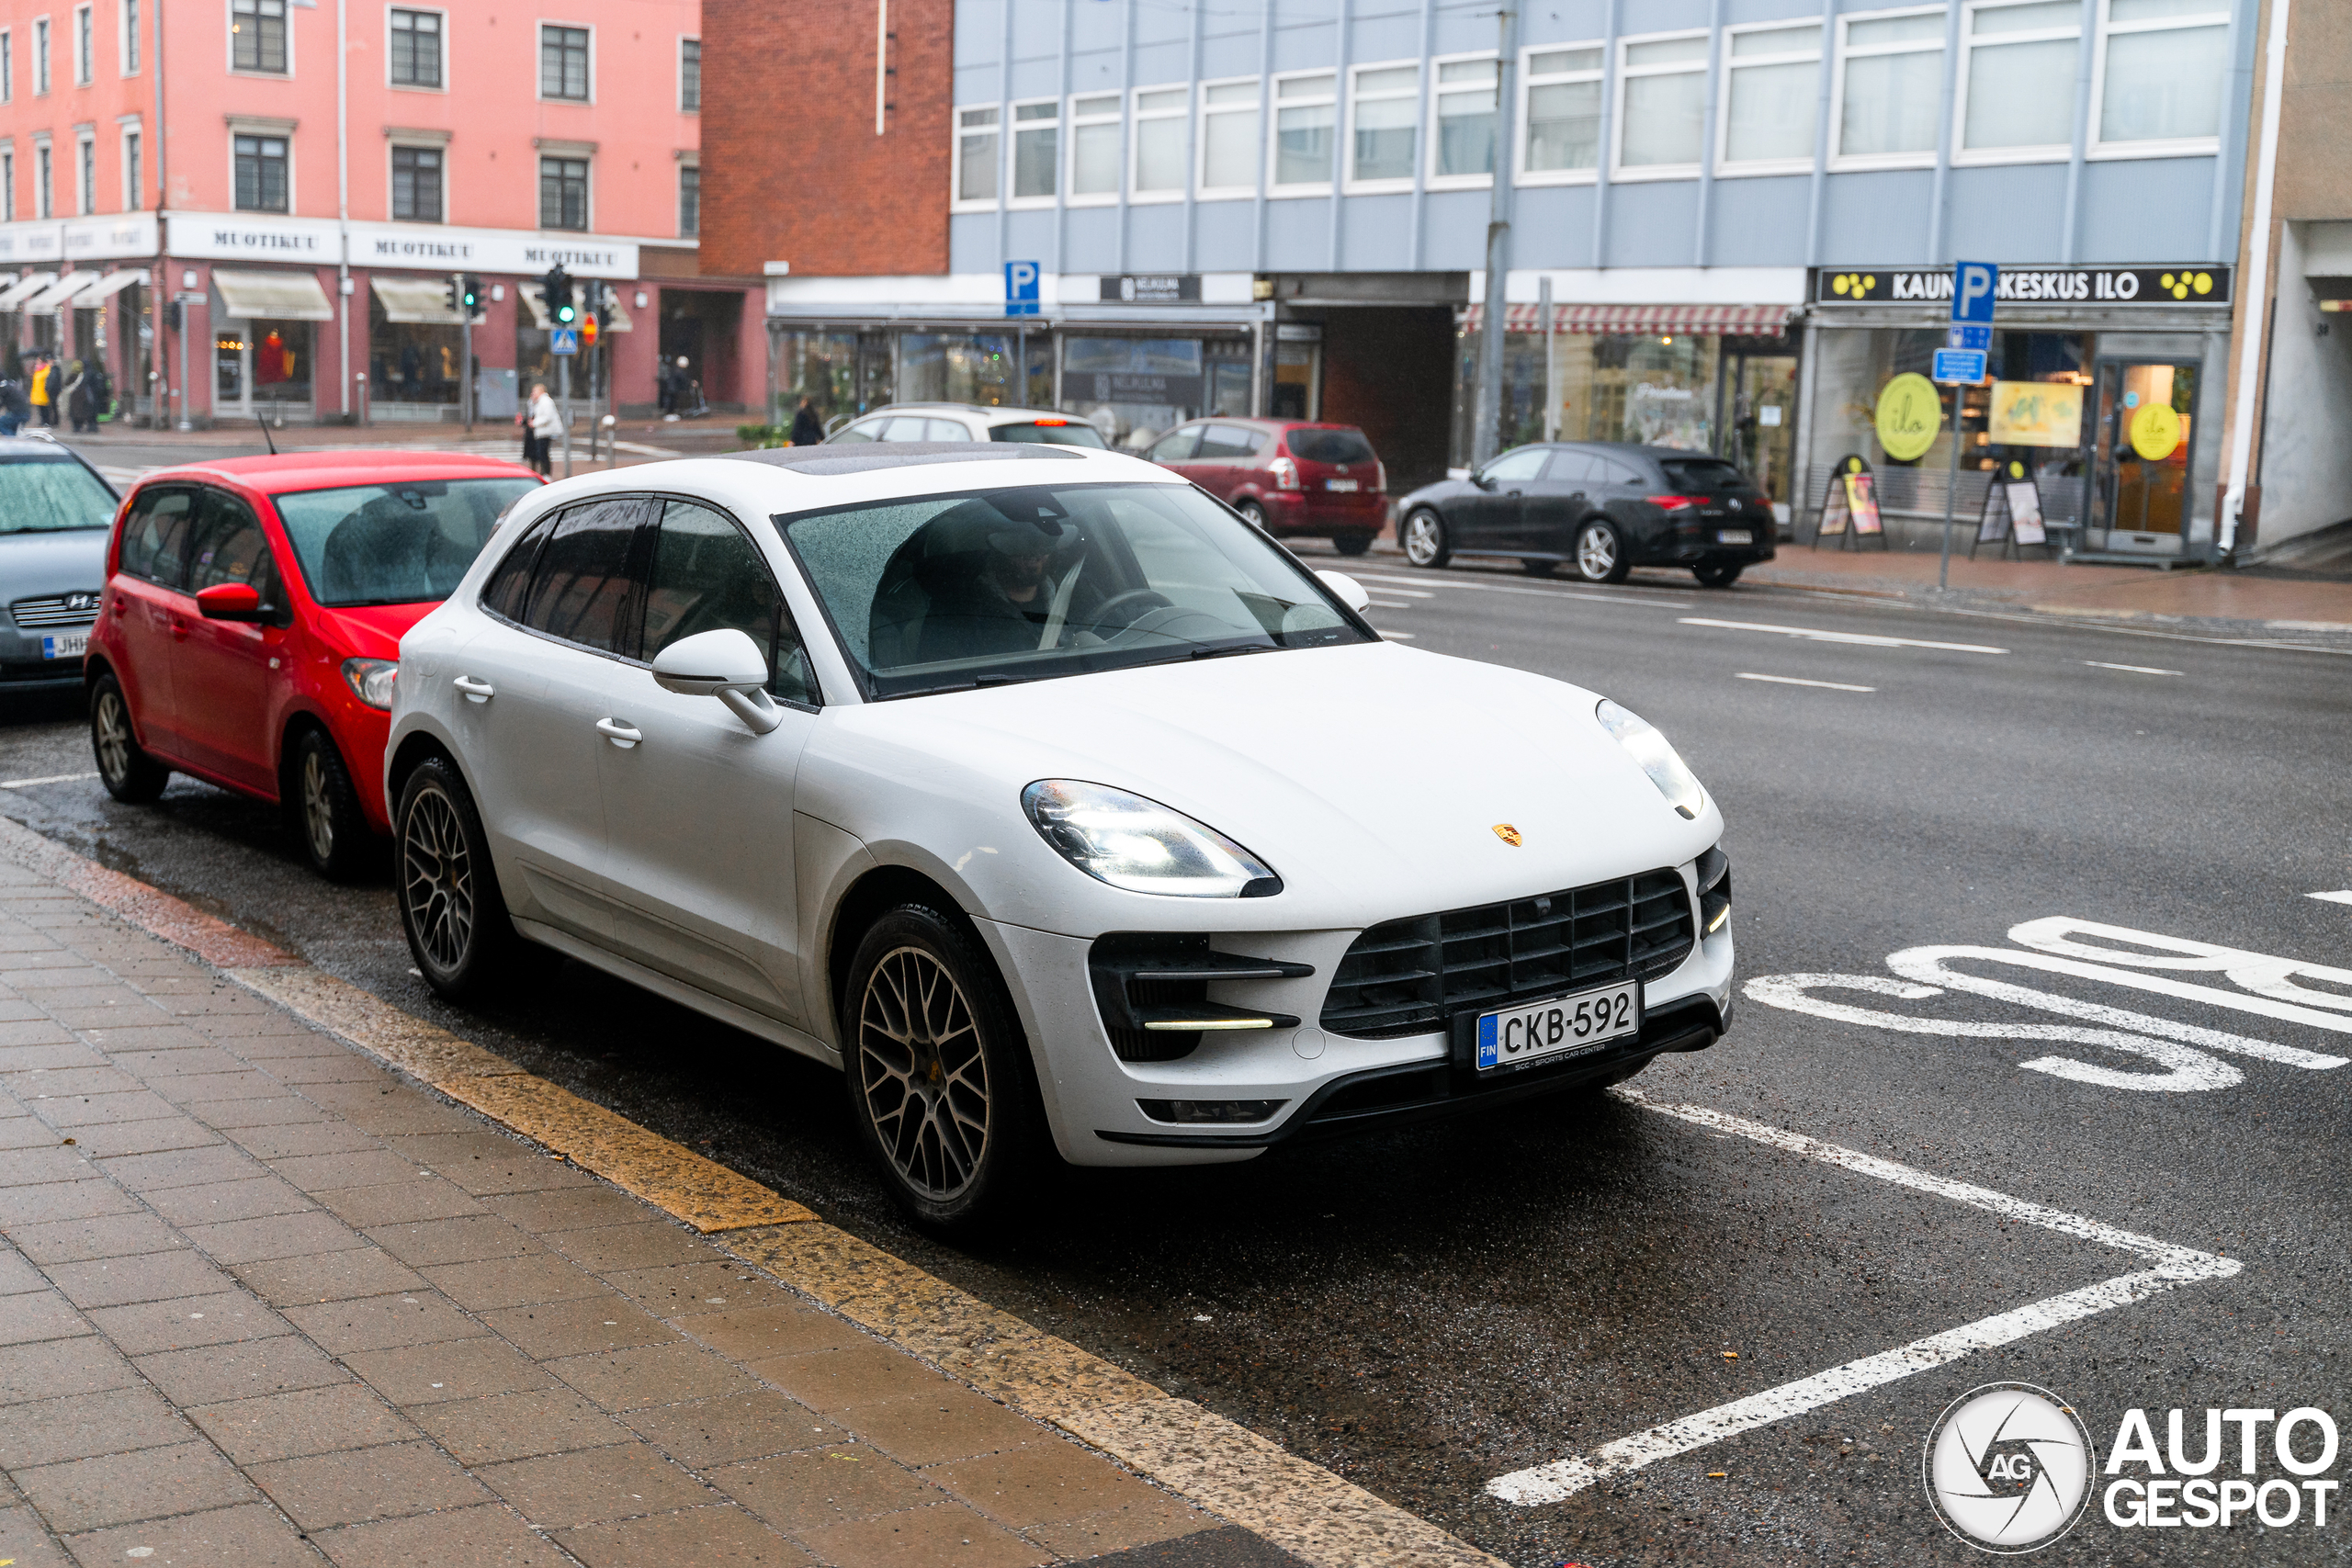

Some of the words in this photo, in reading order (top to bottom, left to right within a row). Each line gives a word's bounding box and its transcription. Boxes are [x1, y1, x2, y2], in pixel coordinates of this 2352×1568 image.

[215, 231, 319, 250] MUOTIKUU
[376, 240, 474, 259] MUOTIKUU
[1012, 264, 1036, 299] P
[1893, 273, 2089, 299] KAUNKESKUS
[2095, 272, 2140, 299] ILO
[1959, 265, 1991, 318] P
[1891, 392, 1928, 435] ilo
[1505, 992, 1630, 1053] CKB-592
[1480, 1044, 1497, 1058] FIN
[1515, 1062, 1530, 1071] SCC
[1535, 1055, 1564, 1066] SPORTS
[1565, 1050, 1579, 1059] CAR
[1580, 1044, 1606, 1055] CENTER
